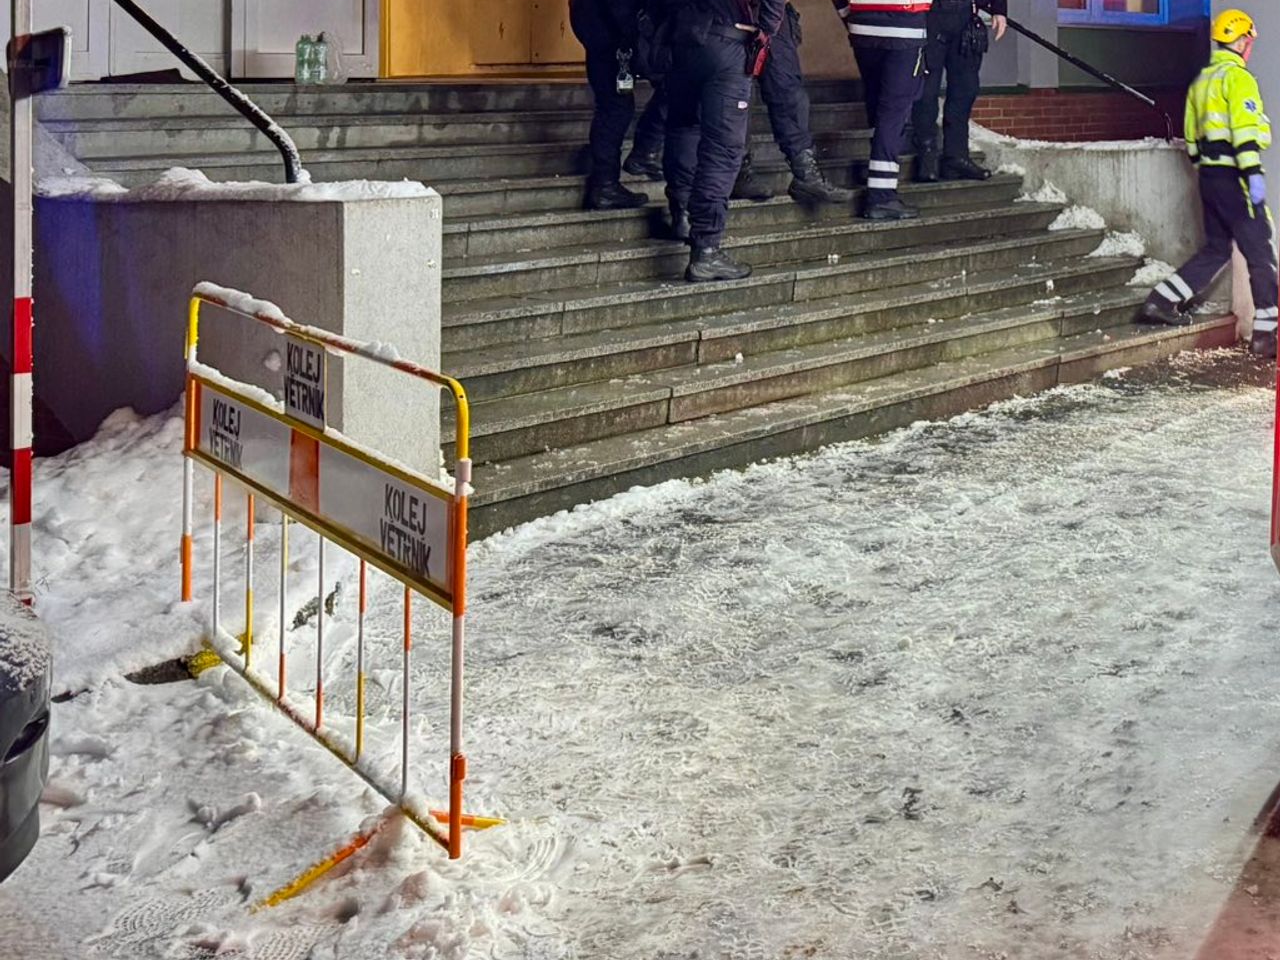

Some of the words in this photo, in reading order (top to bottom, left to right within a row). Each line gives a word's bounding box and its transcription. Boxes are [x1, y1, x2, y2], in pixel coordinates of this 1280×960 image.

[287, 342, 320, 383] KOLEJ
[212, 398, 241, 439] KOLEJ
[384, 483, 426, 536] KOLEJ
